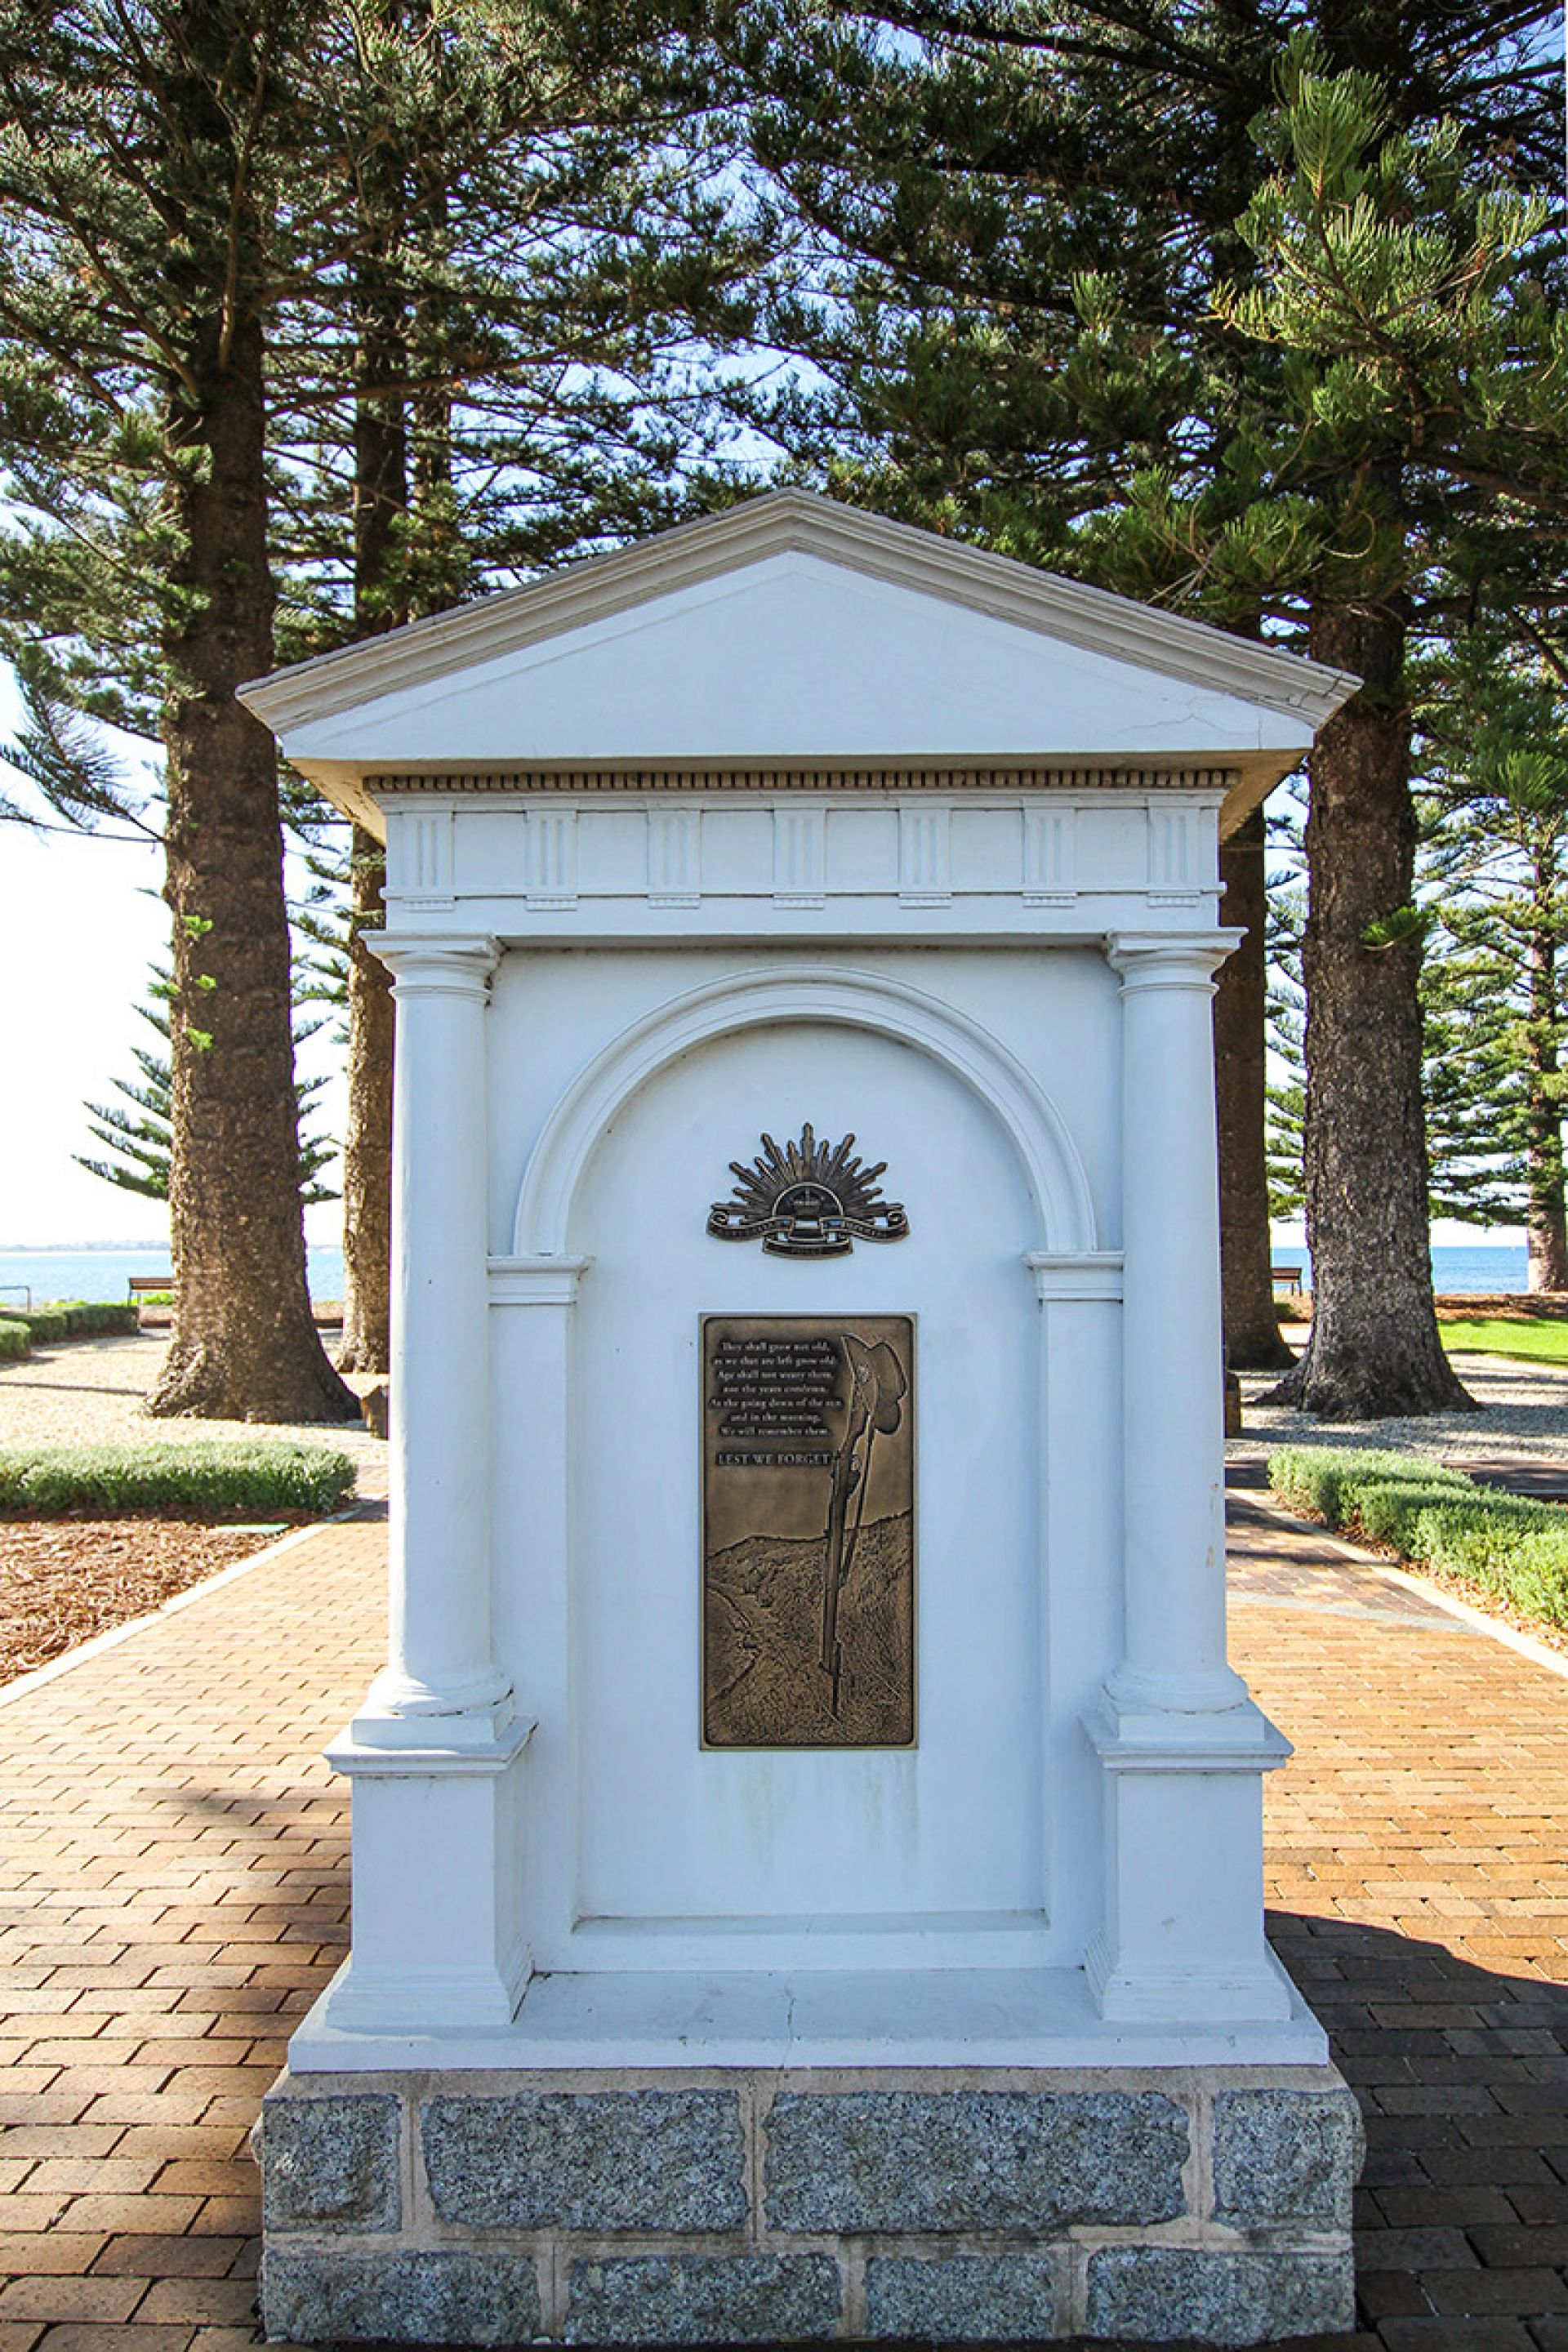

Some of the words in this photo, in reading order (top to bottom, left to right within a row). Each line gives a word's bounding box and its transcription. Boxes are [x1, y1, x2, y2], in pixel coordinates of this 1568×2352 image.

[744, 1342, 767, 1352] shall
[768, 1344, 791, 1353] grow
[740, 1356, 760, 1365] that
[777, 1355, 793, 1365] left
[795, 1358, 817, 1367] grow
[719, 1370, 734, 1382] Age
[737, 1370, 760, 1379] shall
[780, 1372, 804, 1382] weary
[742, 1384, 755, 1392] the
[759, 1387, 782, 1396] years
[724, 1398, 738, 1406] the
[741, 1399, 766, 1410] going
[768, 1397, 795, 1407] down
[795, 1397, 807, 1406] of
[808, 1397, 822, 1406] the
[730, 1413, 747, 1421] and
[751, 1413, 760, 1421] in
[762, 1413, 777, 1421] the
[721, 1427, 736, 1436] We
[738, 1427, 755, 1435] will
[758, 1427, 803, 1436] remember
[719, 1454, 749, 1465] LEST
[752, 1454, 773, 1465] WE
[777, 1454, 831, 1465] FORGET
